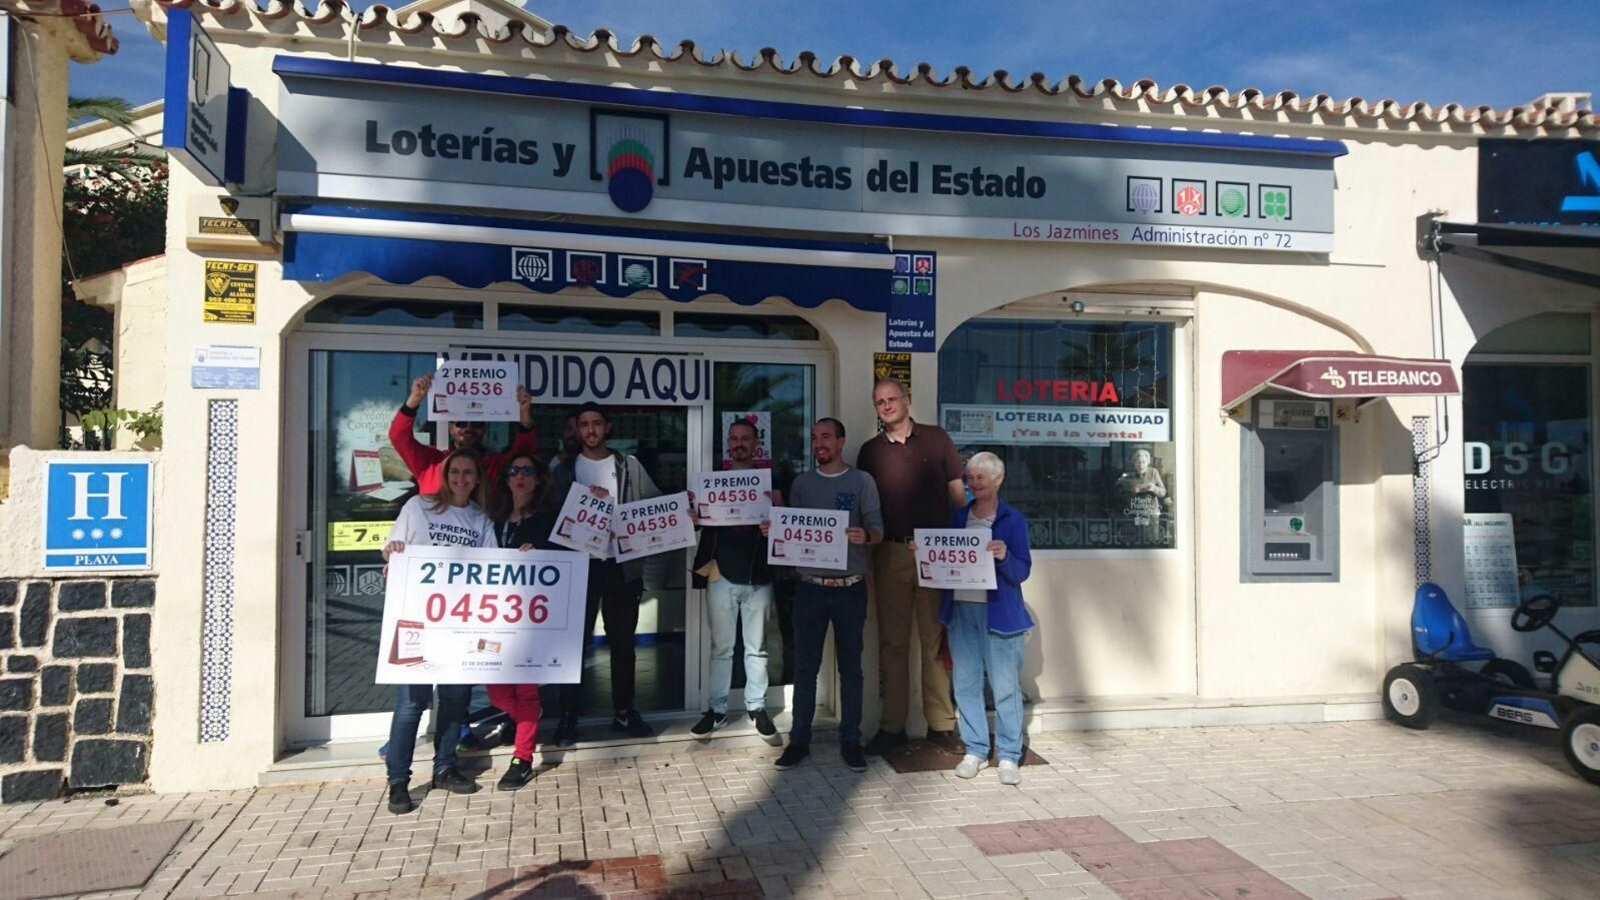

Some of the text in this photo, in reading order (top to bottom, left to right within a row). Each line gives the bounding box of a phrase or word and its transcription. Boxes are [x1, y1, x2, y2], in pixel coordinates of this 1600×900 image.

[365, 120, 1046, 199] Loterías y Apuestas del Estado
[1013, 222, 1041, 239] Los
[1046, 223, 1119, 241] Jazmines
[1131, 226, 1248, 247] Administración
[1275, 233, 1292, 249] 72
[888, 329, 935, 338] Apuestas del
[888, 340, 913, 348] Estado
[454, 368, 507, 379] PREMIO
[624, 356, 711, 403] AQUI
[1348, 370, 1443, 387] TELEBANCO
[445, 381, 503, 396] 04536
[996, 380, 1119, 403] LOTERIA
[995, 411, 1064, 424] LOTERIA
[1069, 412, 1090, 424] DE
[1094, 413, 1164, 426] NAVIDAD
[1011, 428, 1041, 438] ¡Ya
[1064, 429, 1081, 438] la
[1086, 430, 1143, 439] venta!
[714, 475, 760, 488] PREMIO
[67, 471, 129, 520] H
[707, 489, 758, 504] 04536
[631, 500, 679, 517] PREMIO
[627, 513, 678, 536] 04536
[790, 514, 838, 528] PREMIO
[440, 524, 479, 538] PREMIO
[783, 527, 834, 543] 04536
[429, 531, 477, 547] VENDIDO
[935, 536, 980, 547] PREMIO
[74, 554, 119, 566] PLAYA
[928, 549, 978, 564] 04536
[419, 562, 561, 587] 2º PREMIO
[425, 592, 549, 624] 04536
[1497, 707, 1533, 722] BERG
